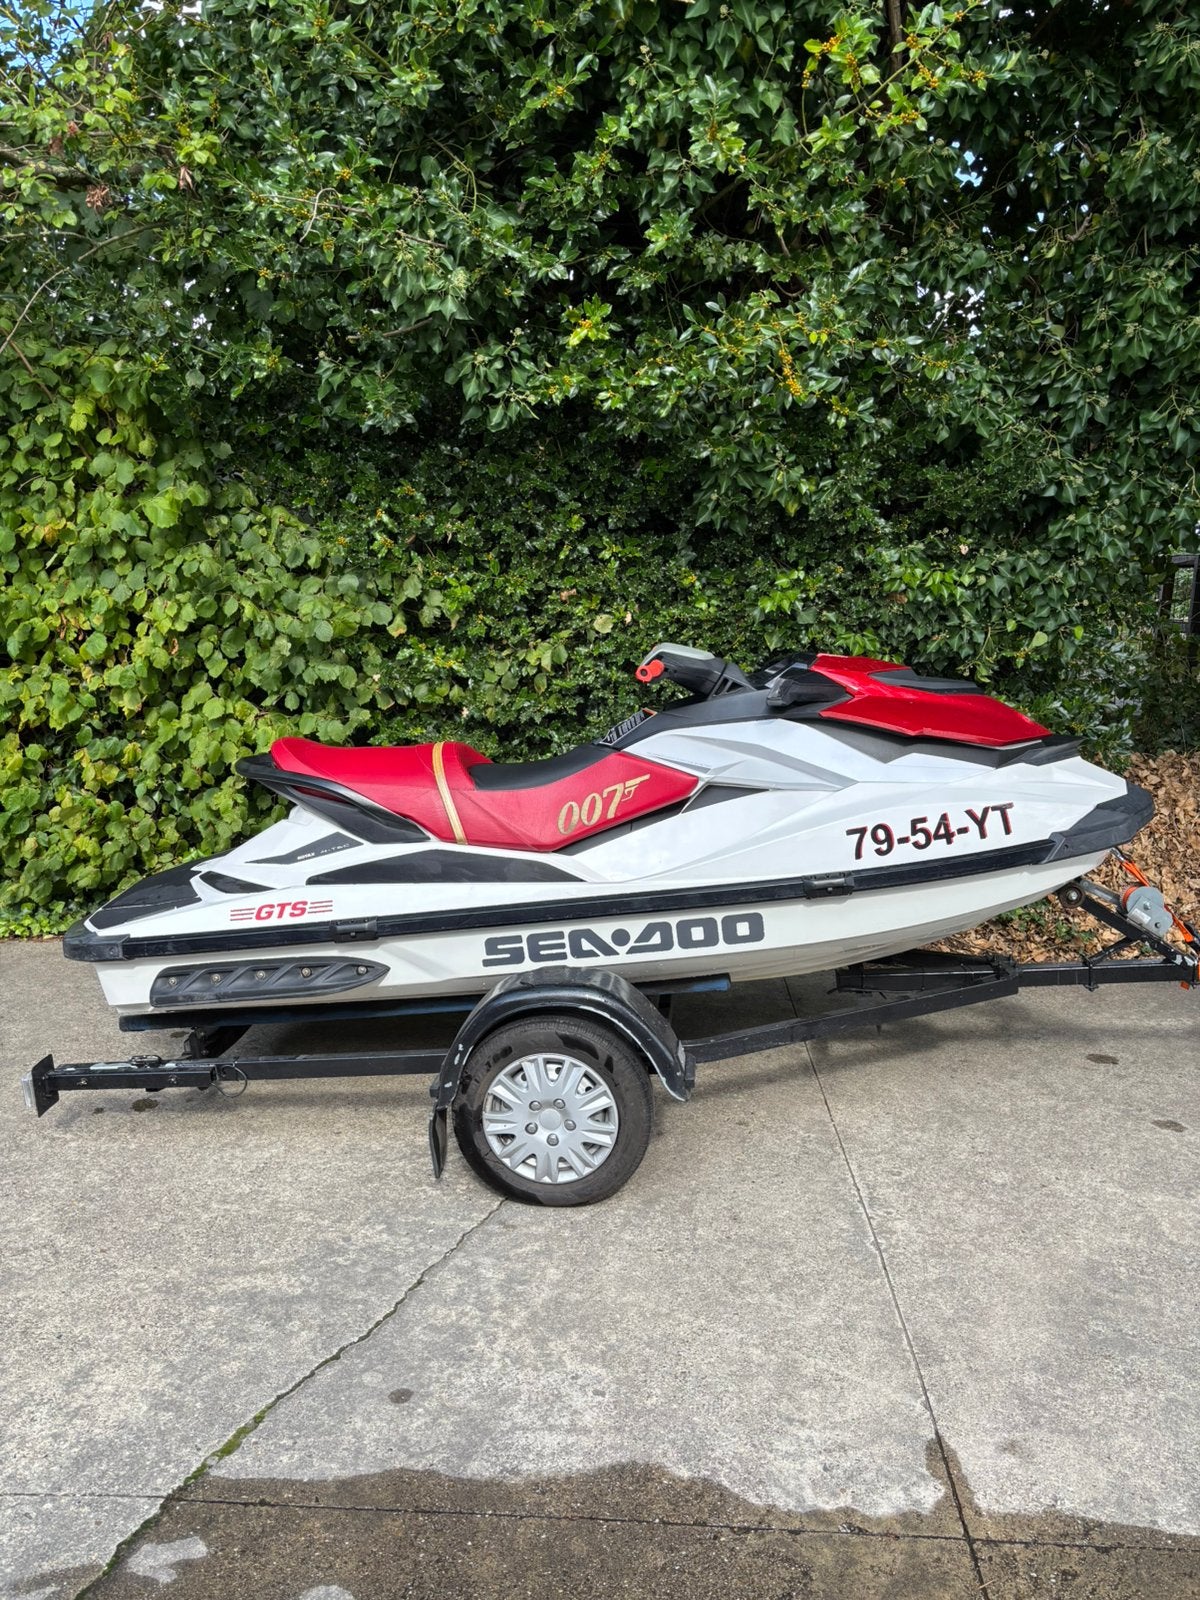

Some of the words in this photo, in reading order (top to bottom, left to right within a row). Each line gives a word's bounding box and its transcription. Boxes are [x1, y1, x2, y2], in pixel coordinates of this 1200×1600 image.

[557, 782, 627, 835] 007
[846, 802, 1014, 860] 79-54-YT
[255, 900, 308, 921] GTS
